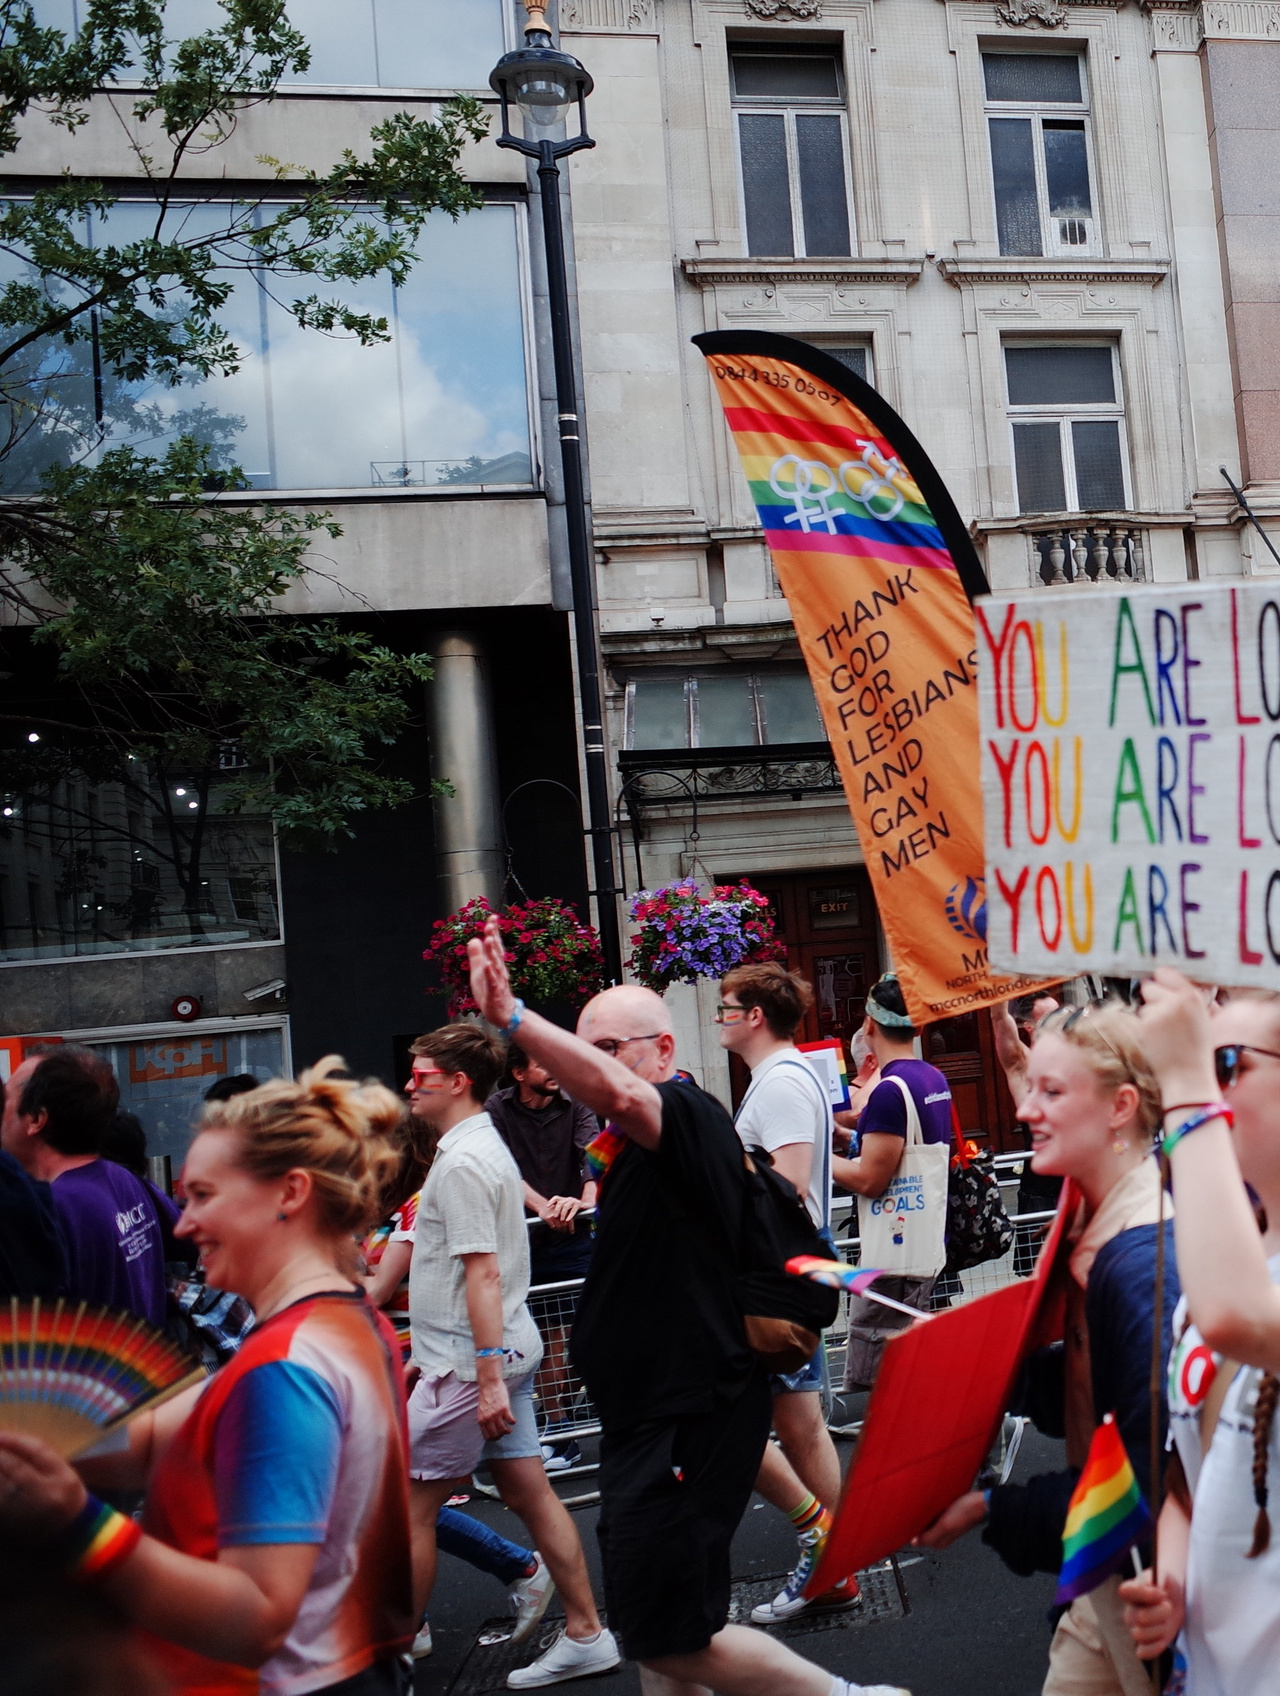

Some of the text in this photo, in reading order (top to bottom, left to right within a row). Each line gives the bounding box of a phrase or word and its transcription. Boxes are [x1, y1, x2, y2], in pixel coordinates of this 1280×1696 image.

[715, 366, 843, 407] 0844 335 0507
[816, 567, 919, 660] THANK
[830, 630, 890, 694] GOD
[975, 603, 1068, 733] YOU
[1109, 596, 1206, 728] ARE
[837, 669, 895, 731] FOR
[847, 649, 979, 766] LESBIANS
[863, 738, 923, 804] AND
[988, 735, 1083, 849] YOU
[1111, 732, 1211, 844] ARE
[870, 776, 928, 838] GAY
[881, 811, 950, 878] MEN
[821, 902, 848, 913] EXIT
[994, 861, 1095, 955] YOU
[1114, 862, 1206, 959] ARE
[945, 971, 988, 990] NORTH
[871, 1194, 925, 1215] GOALS
